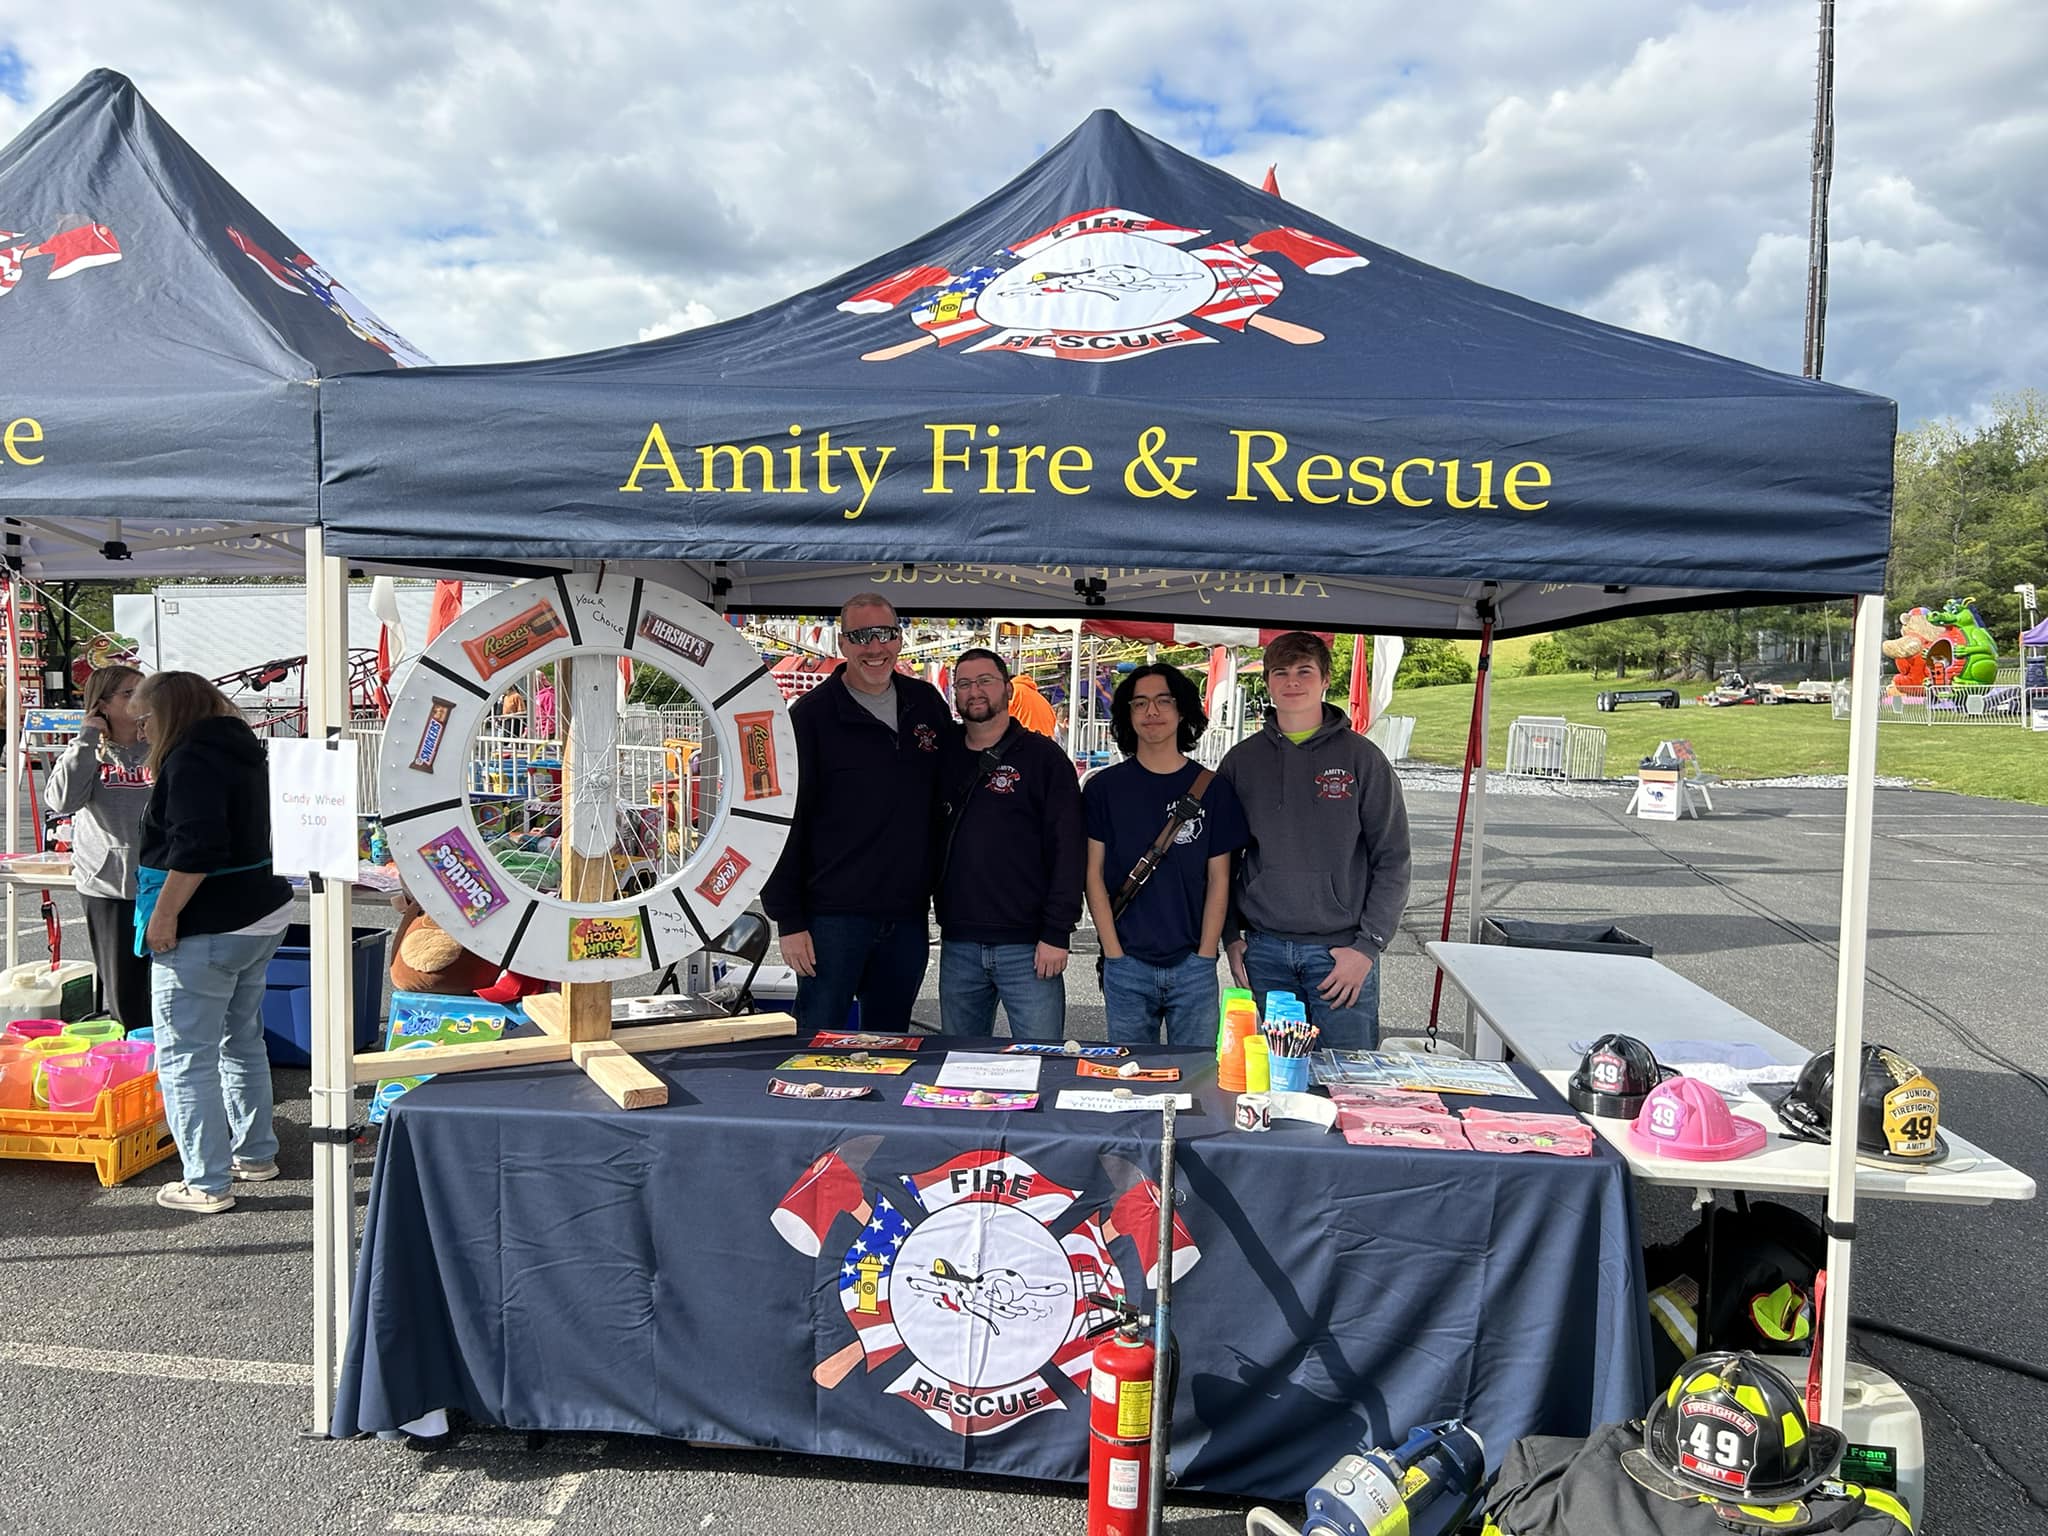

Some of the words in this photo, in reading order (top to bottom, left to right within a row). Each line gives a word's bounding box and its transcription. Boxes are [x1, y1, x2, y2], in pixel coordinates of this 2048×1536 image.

[1052, 215, 1153, 239] FIRE
[1002, 328, 1186, 352] RESCUE
[0, 417, 45, 466] e
[619, 422, 897, 519] Amity
[924, 422, 1094, 497] Fire
[1123, 424, 1198, 500] &
[1226, 428, 1552, 512] Rescue
[592, 610, 625, 636] Choice
[483, 623, 529, 657] Reese's
[651, 619, 705, 657] HERSHEY'S
[419, 721, 442, 765] SNICKERS
[1323, 768, 1347, 777] AMITY
[282, 792, 311, 806] Candy
[315, 794, 345, 806] Wheel
[301, 815, 327, 826] $1.00
[435, 843, 494, 910] Skittles
[584, 927, 624, 943] PATCH
[588, 938, 624, 954] SOUR
[1594, 1062, 1619, 1083] 49
[1905, 1088, 1932, 1100] JUNIOR
[1652, 1105, 1676, 1128] 49
[1892, 1102, 1935, 1118] FIREFIGHTER
[1900, 1115, 1933, 1141] 49
[1906, 1142, 1926, 1150] AMITY
[950, 1168, 1034, 1201] FIRE
[910, 1376, 1044, 1418] RESCUE
[1688, 1402, 1752, 1431] FIREFIGHTER
[1690, 1422, 1740, 1467] 49
[1851, 1447, 1888, 1460] Foam
[1695, 1460, 1729, 1479] AMITY
